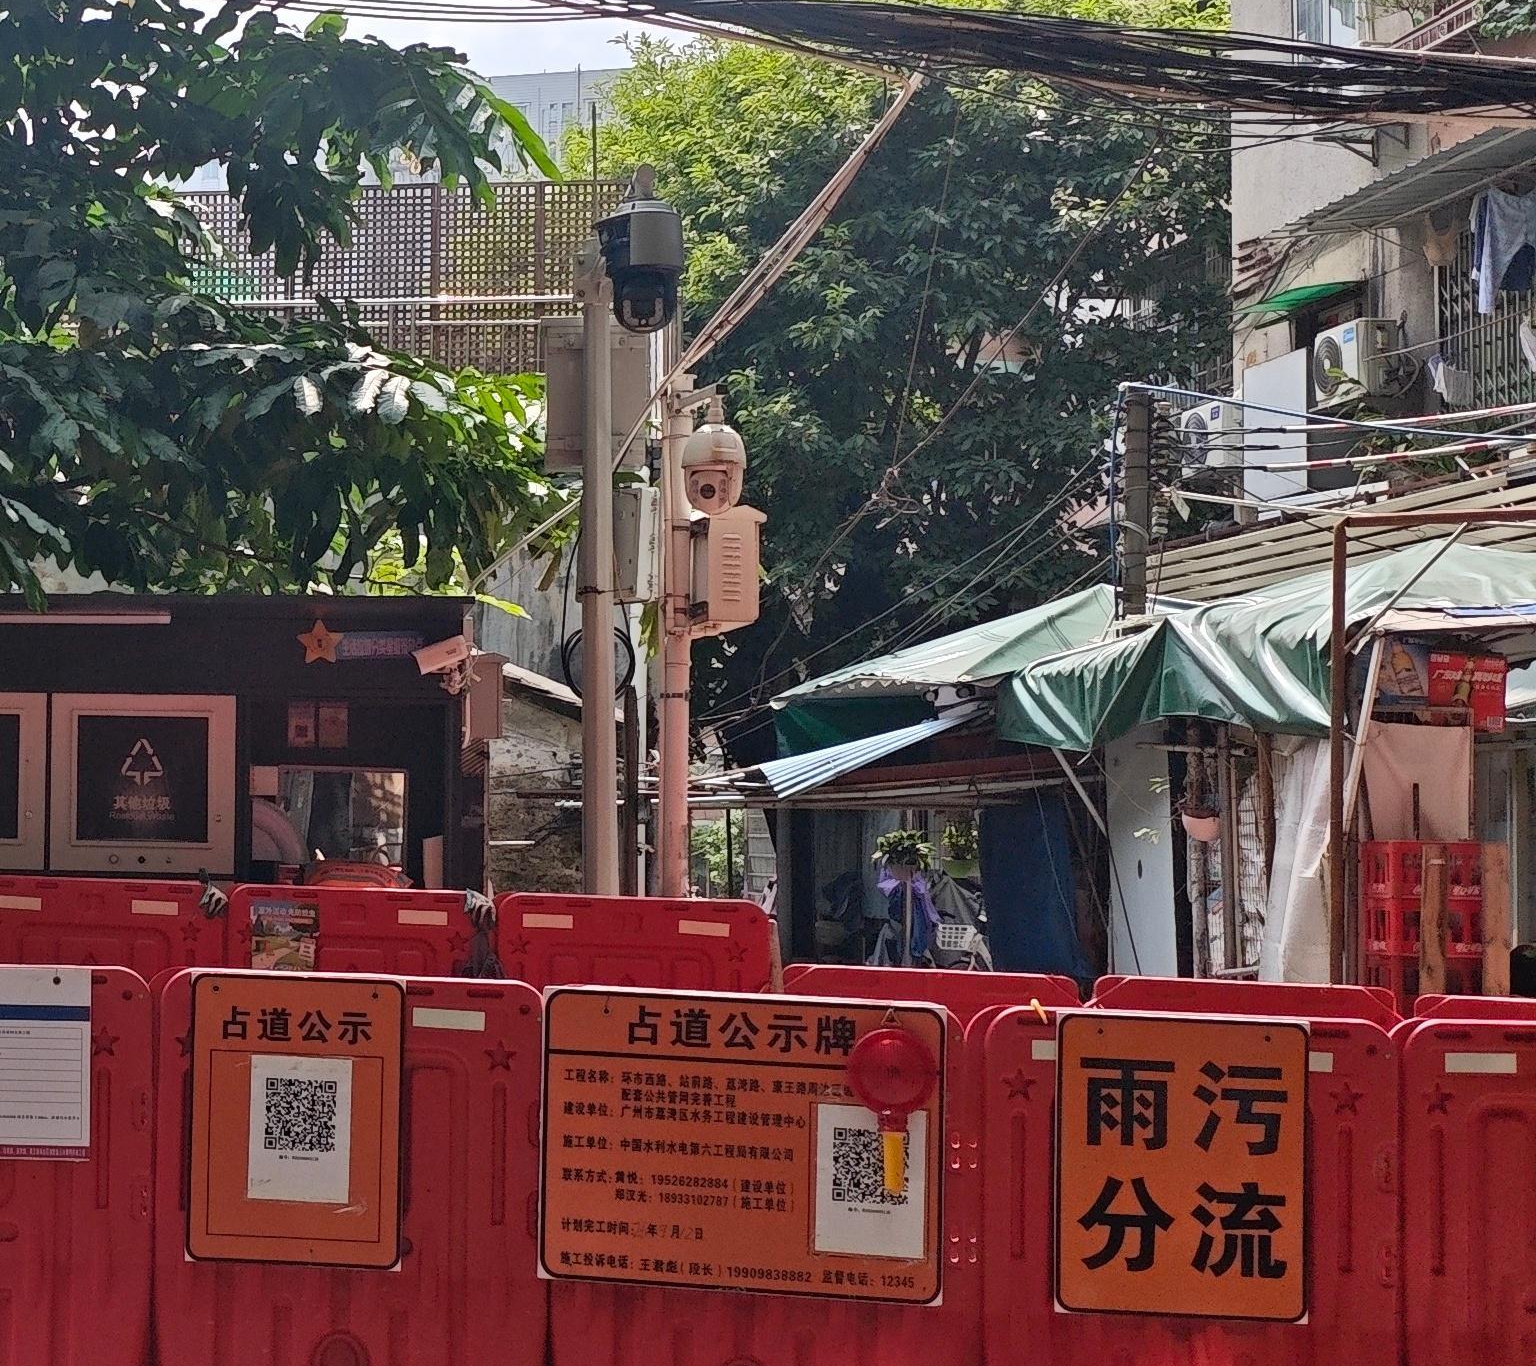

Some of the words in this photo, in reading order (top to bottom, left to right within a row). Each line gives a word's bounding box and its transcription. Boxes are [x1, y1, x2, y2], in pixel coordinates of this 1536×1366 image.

[113, 794, 172, 811] 其他垃圾
[220, 1004, 375, 1047] 占道公示
[625, 1005, 857, 1058] 占道公示牌
[1078, 1055, 1290, 1157] 雨污
[1076, 1175, 1289, 1280] 分流
